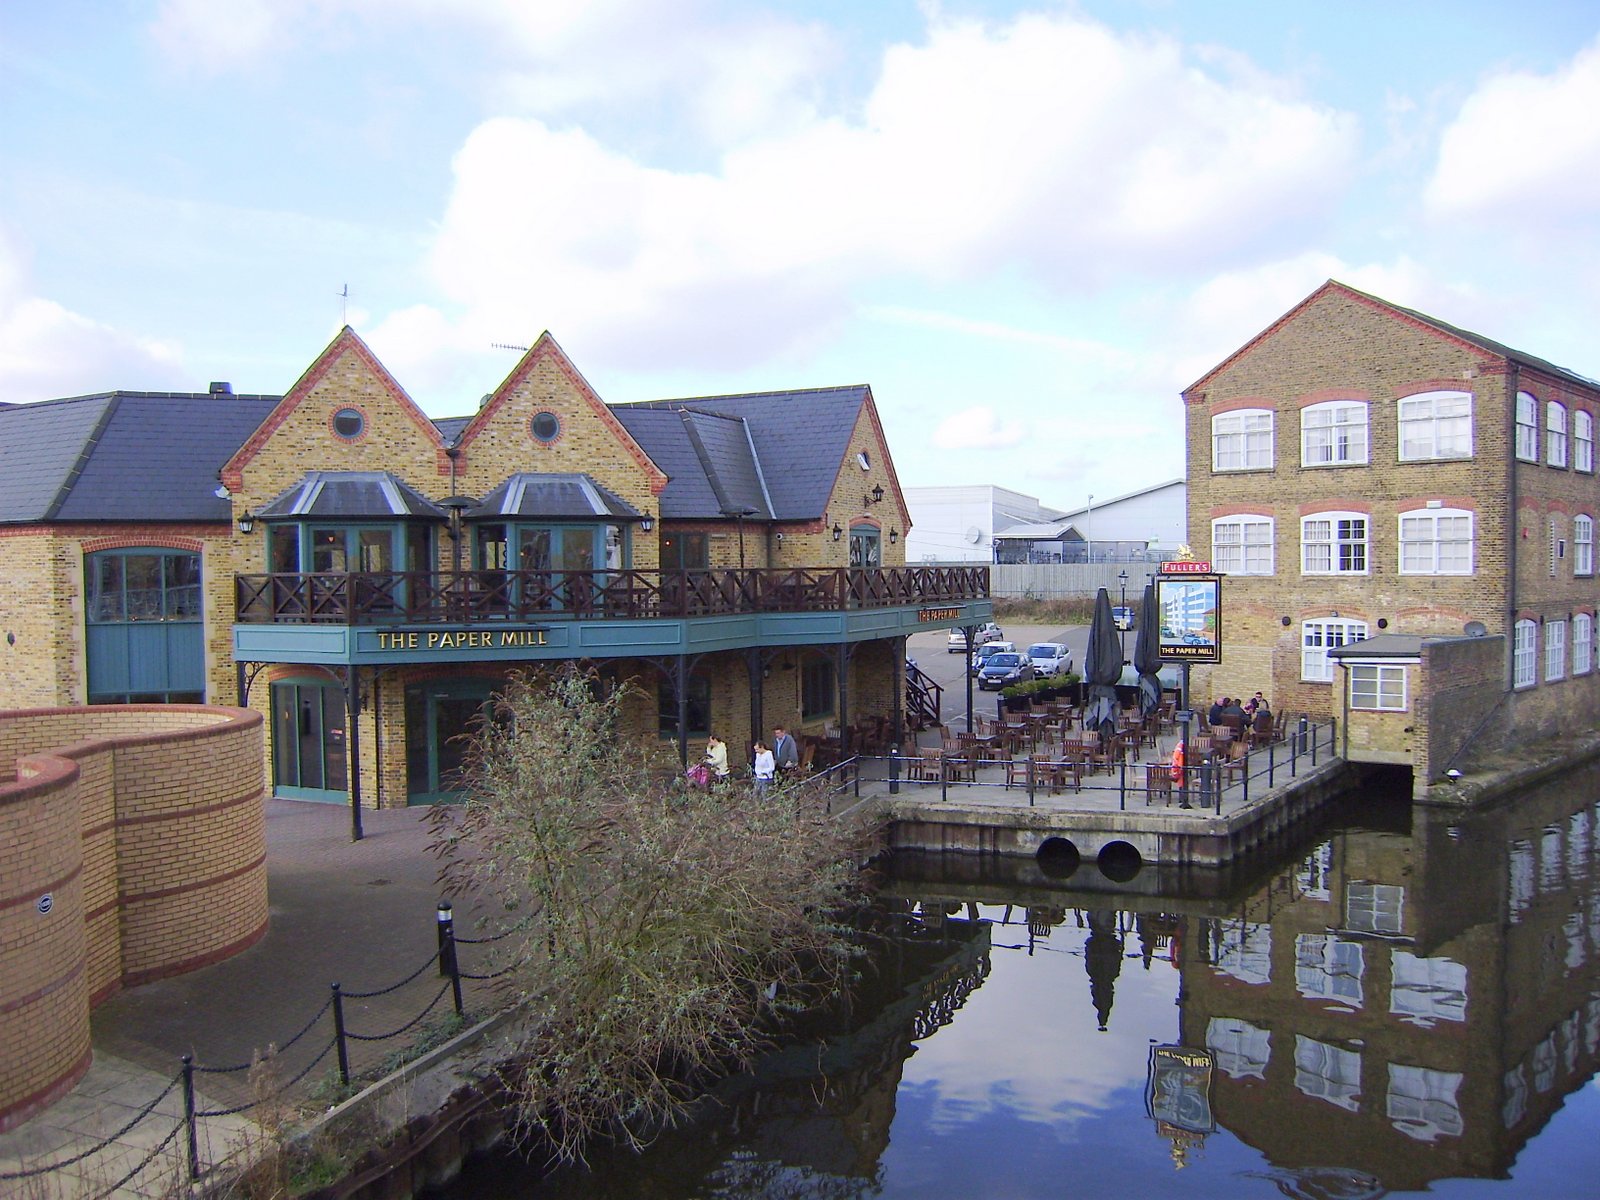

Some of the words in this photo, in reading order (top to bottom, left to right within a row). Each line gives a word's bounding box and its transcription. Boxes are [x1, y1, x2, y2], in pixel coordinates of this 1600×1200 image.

[378, 632, 418, 649] THE
[427, 631, 493, 648] PAPER
[501, 631, 548, 646] MILL
[1176, 647, 1197, 655] PAPER
